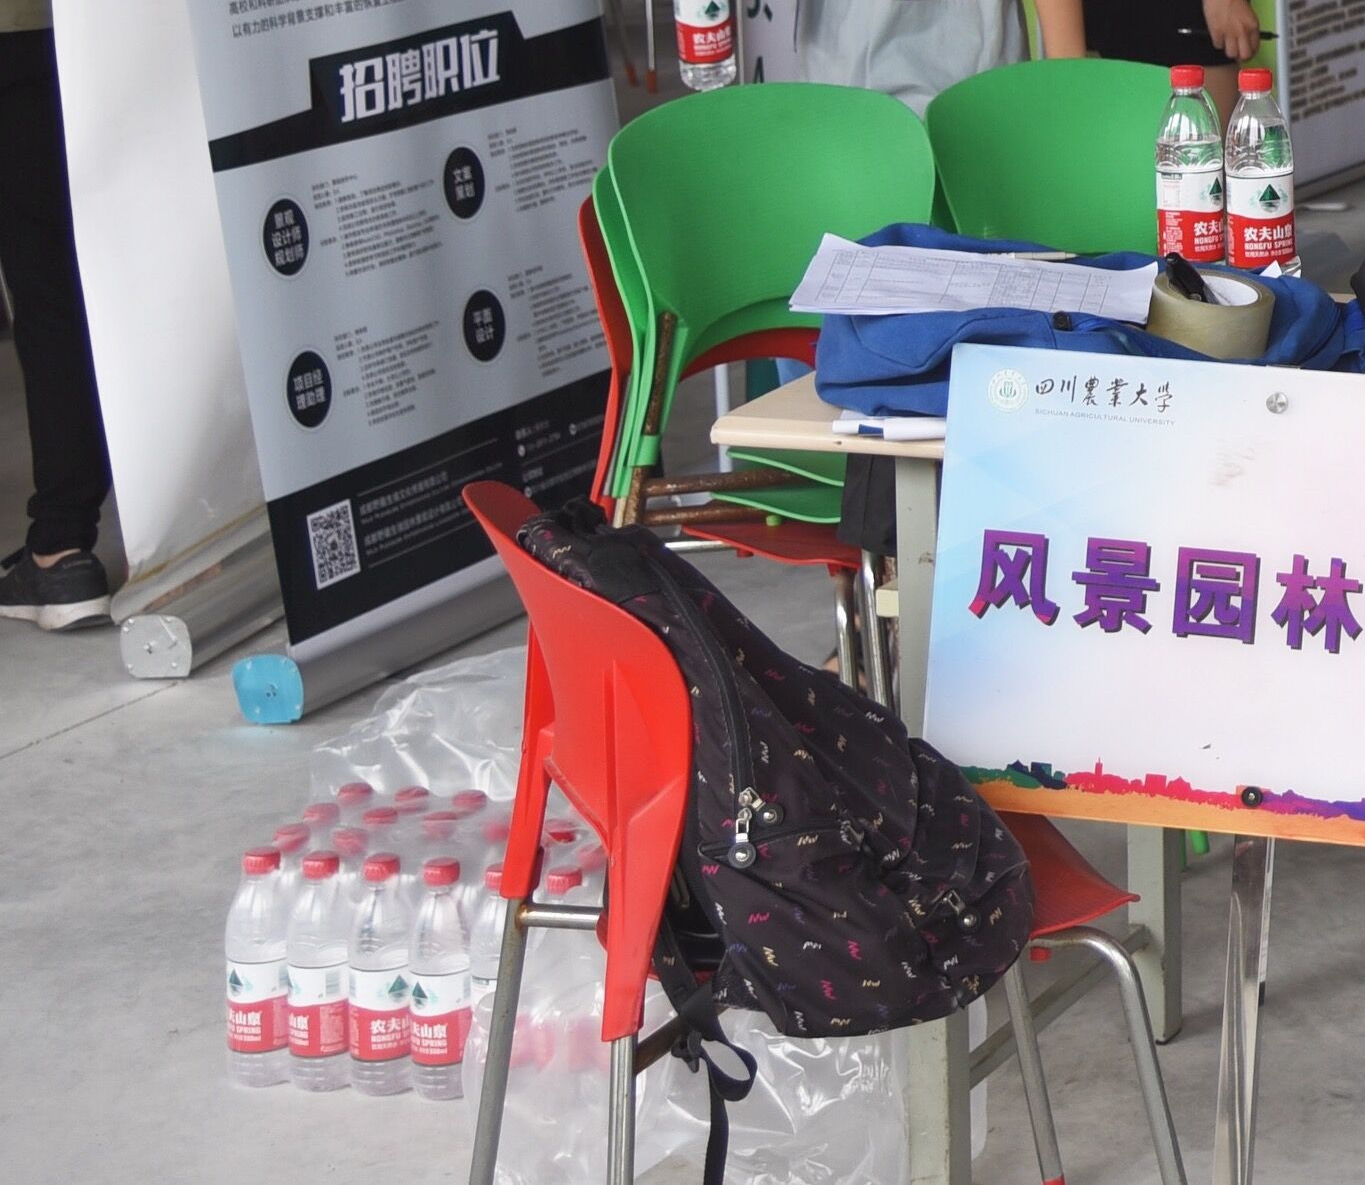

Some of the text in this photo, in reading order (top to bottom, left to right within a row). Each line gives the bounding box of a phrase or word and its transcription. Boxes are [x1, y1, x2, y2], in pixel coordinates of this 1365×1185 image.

[338, 28, 501, 123] 招聘职位
[1243, 223, 1293, 242] 农夫山泉
[1034, 408, 1176, 426] SICHUAN AGRICULTURAL UNIVERSITY
